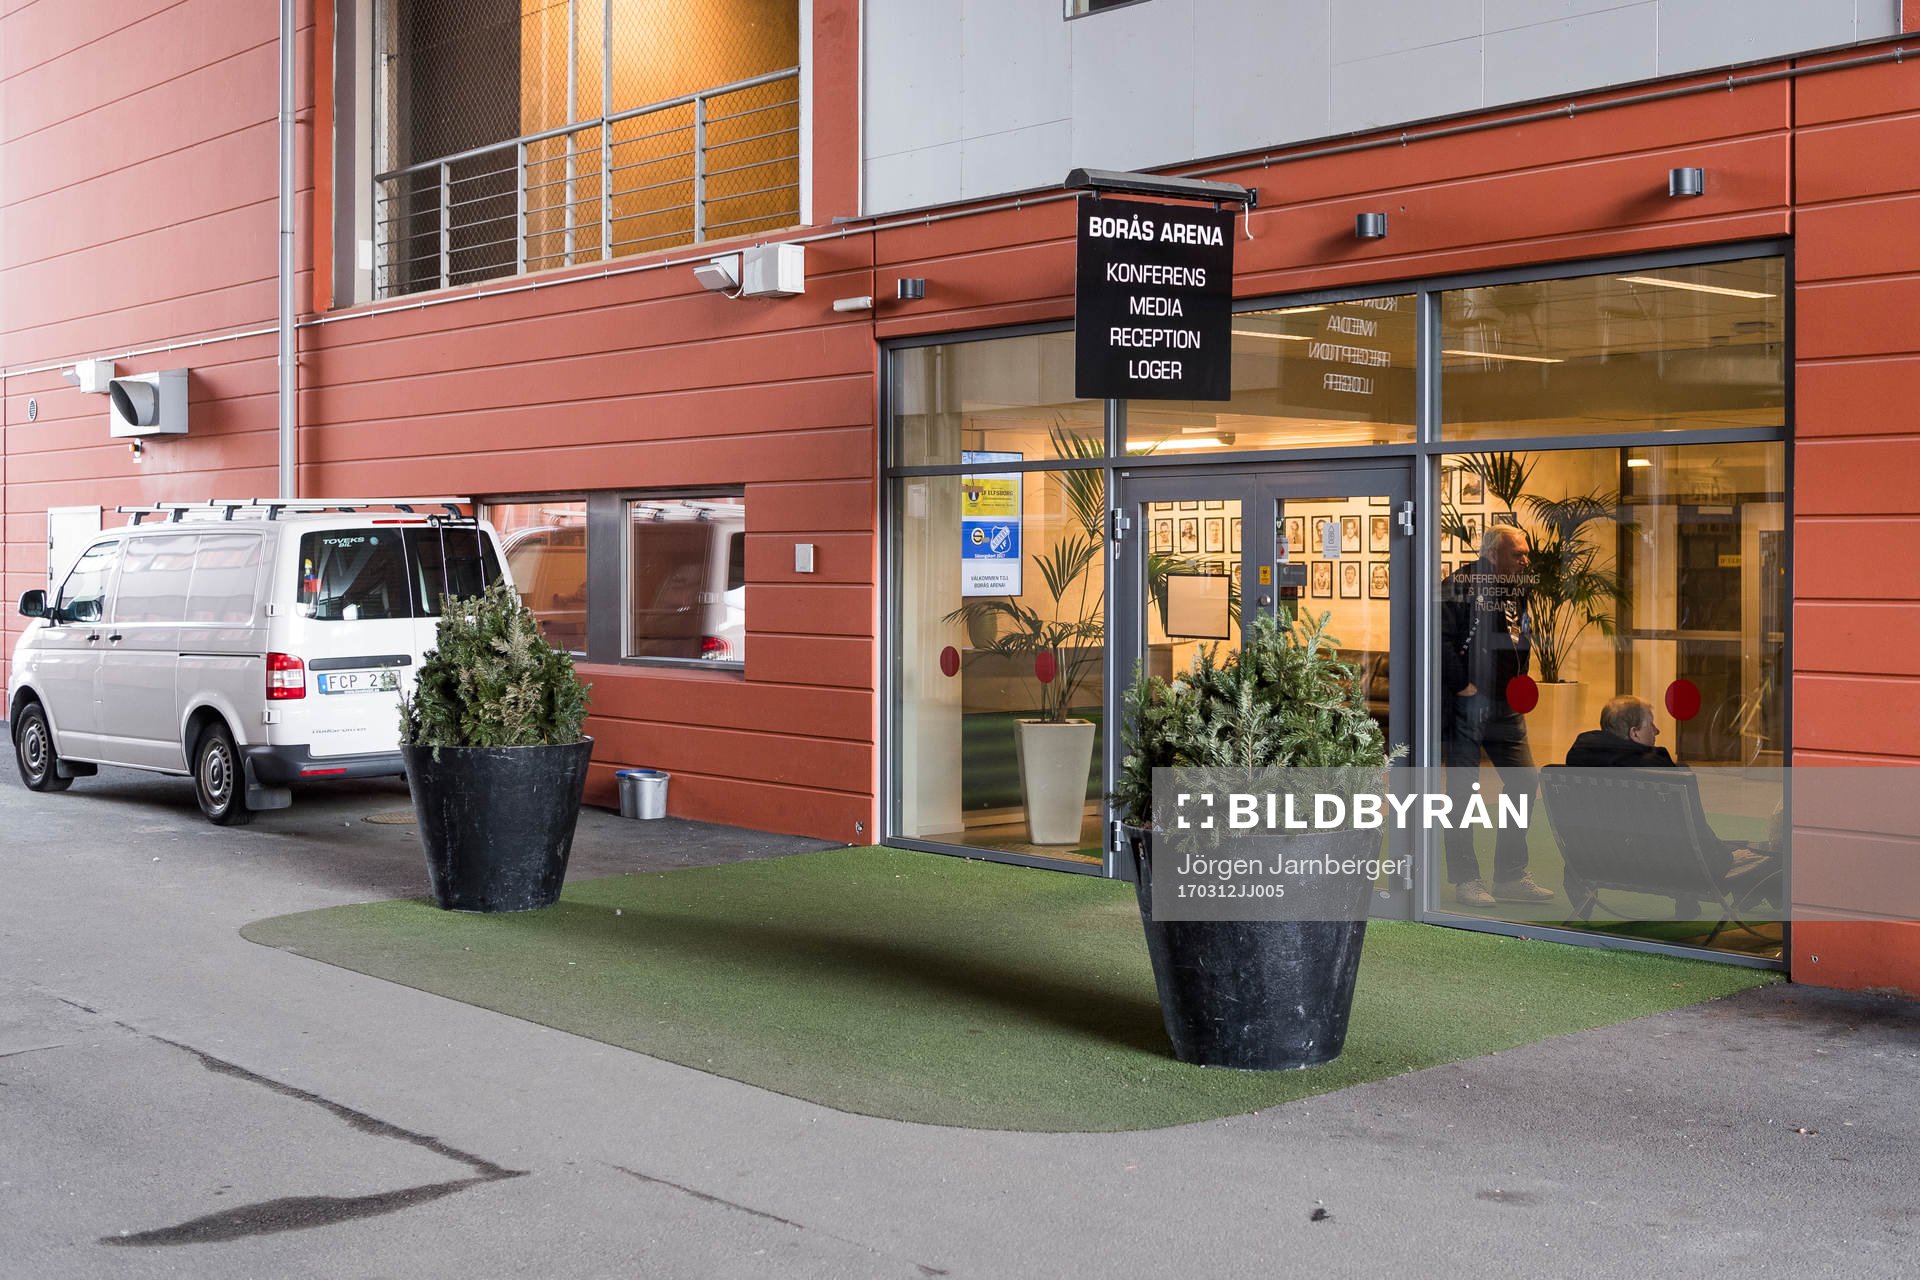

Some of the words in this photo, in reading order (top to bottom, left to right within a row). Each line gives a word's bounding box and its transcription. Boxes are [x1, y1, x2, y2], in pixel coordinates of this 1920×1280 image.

[1089, 214, 1154, 241] BORÅS
[1160, 222, 1224, 247] ARENA
[1106, 262, 1206, 287] KONFERENS
[1129, 296, 1183, 317] MEDIA
[1110, 327, 1201, 349] RECEPTION
[1129, 360, 1182, 380] LOGER
[323, 536, 365, 545] TOVEKS
[1467, 586, 1475, 596] &
[329, 674, 358, 689] FCP
